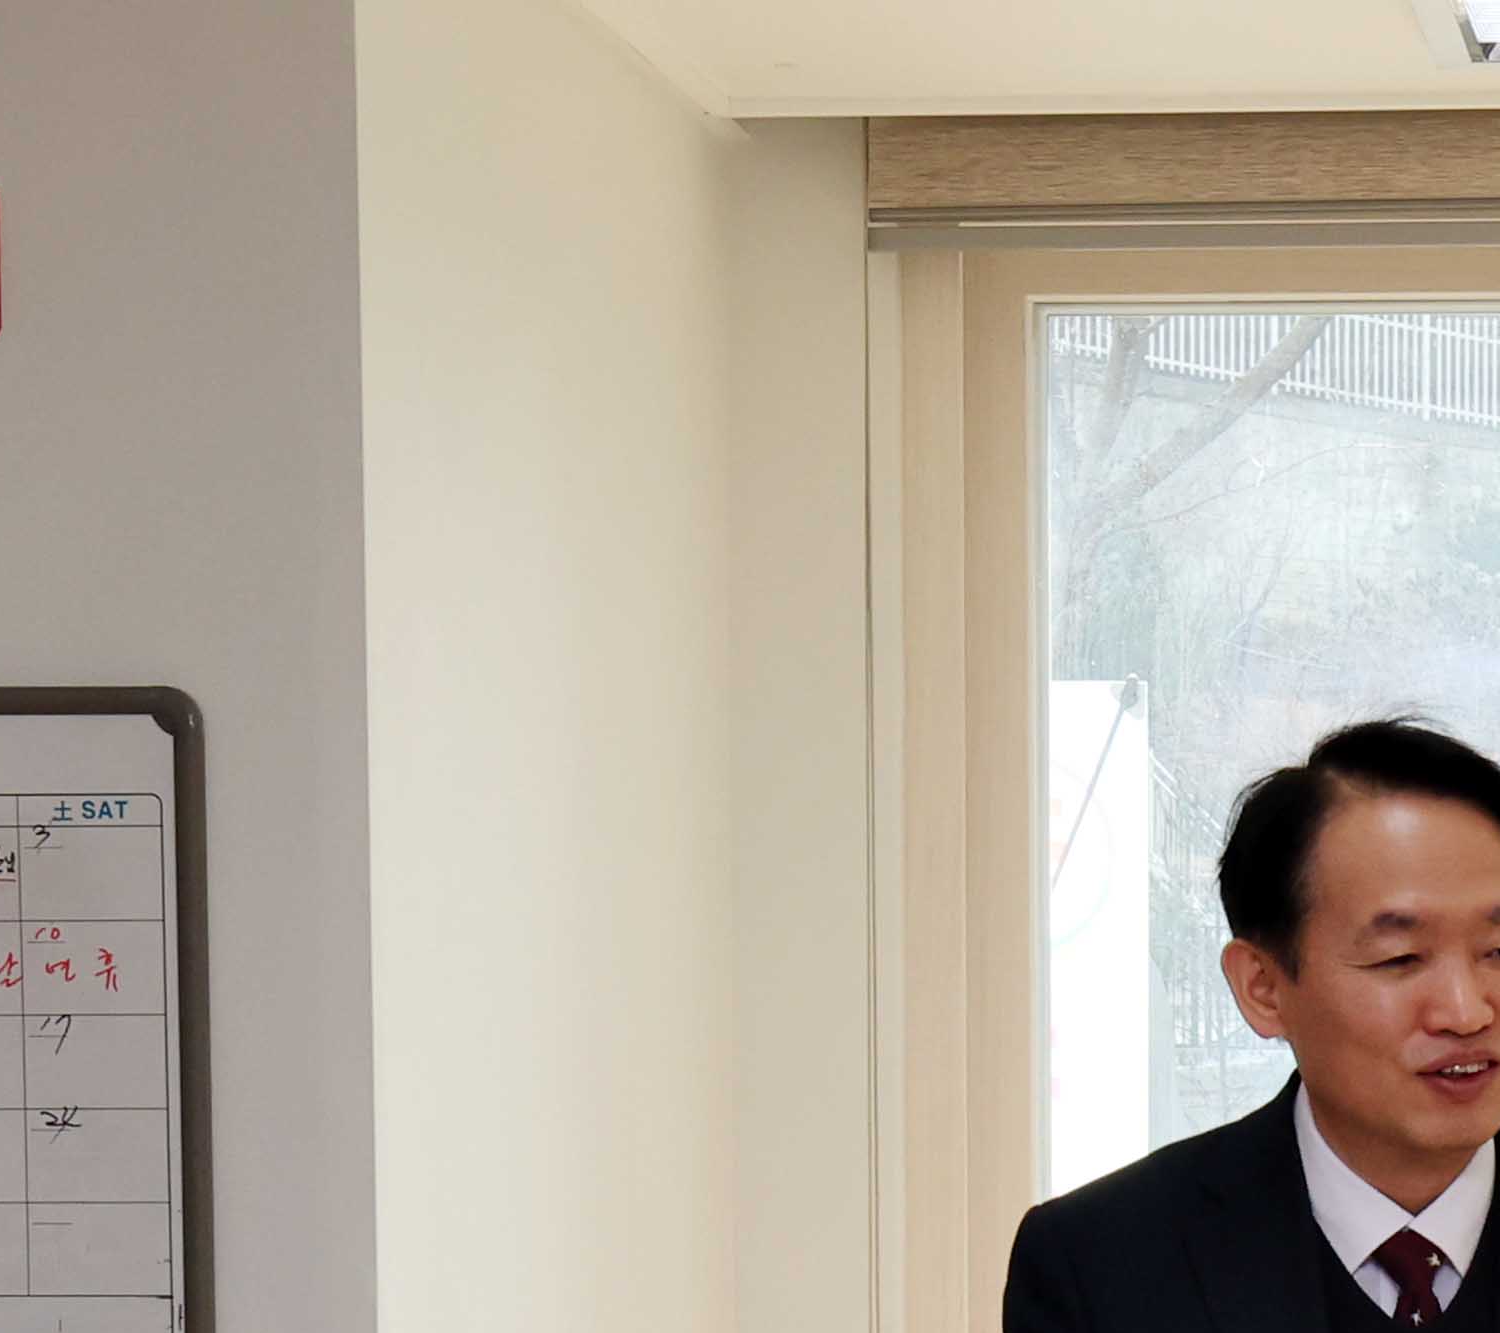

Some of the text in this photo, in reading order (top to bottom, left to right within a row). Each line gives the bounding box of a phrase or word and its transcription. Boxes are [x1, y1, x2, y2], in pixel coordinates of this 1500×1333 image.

[53, 801, 128, 822] 土 SAT
[33, 825, 50, 848] 3
[40, 1015, 73, 1054] 17
